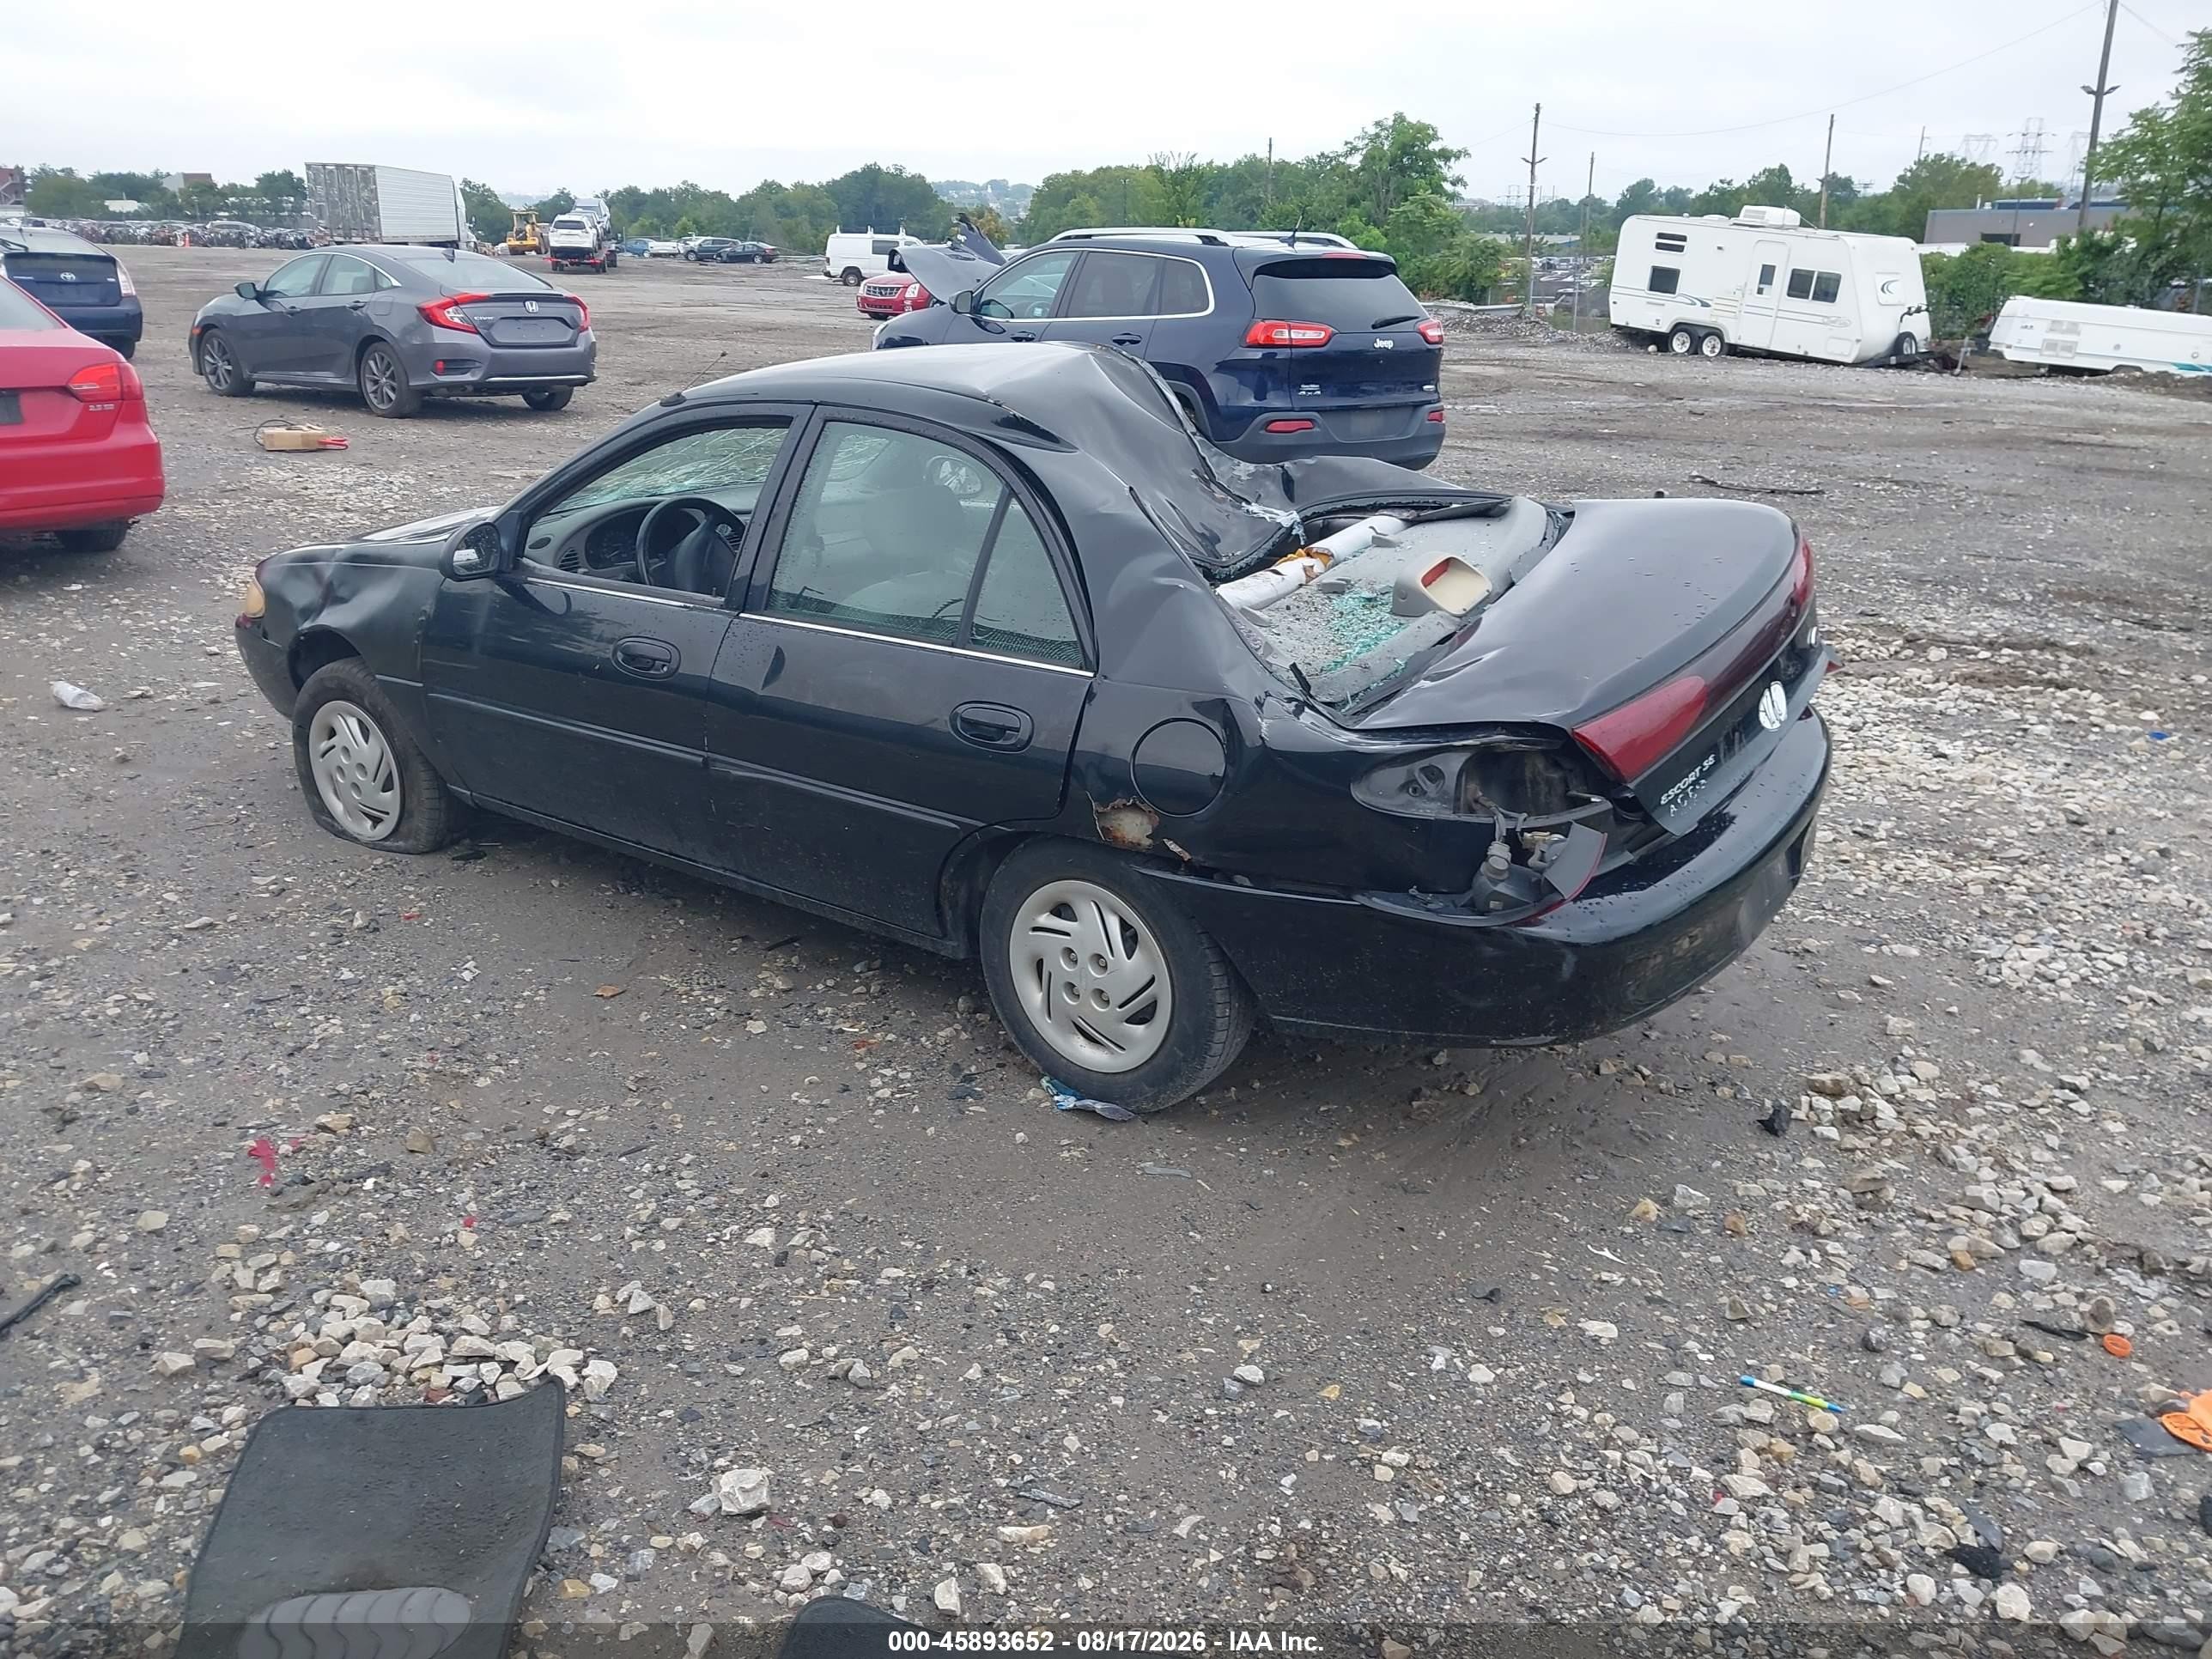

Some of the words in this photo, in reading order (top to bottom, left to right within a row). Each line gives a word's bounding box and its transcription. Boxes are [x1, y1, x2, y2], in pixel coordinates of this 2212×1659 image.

[1374, 337, 1394, 349] Jeep
[1660, 766, 1701, 805] ESCORT
[1702, 754, 1717, 772] SE
